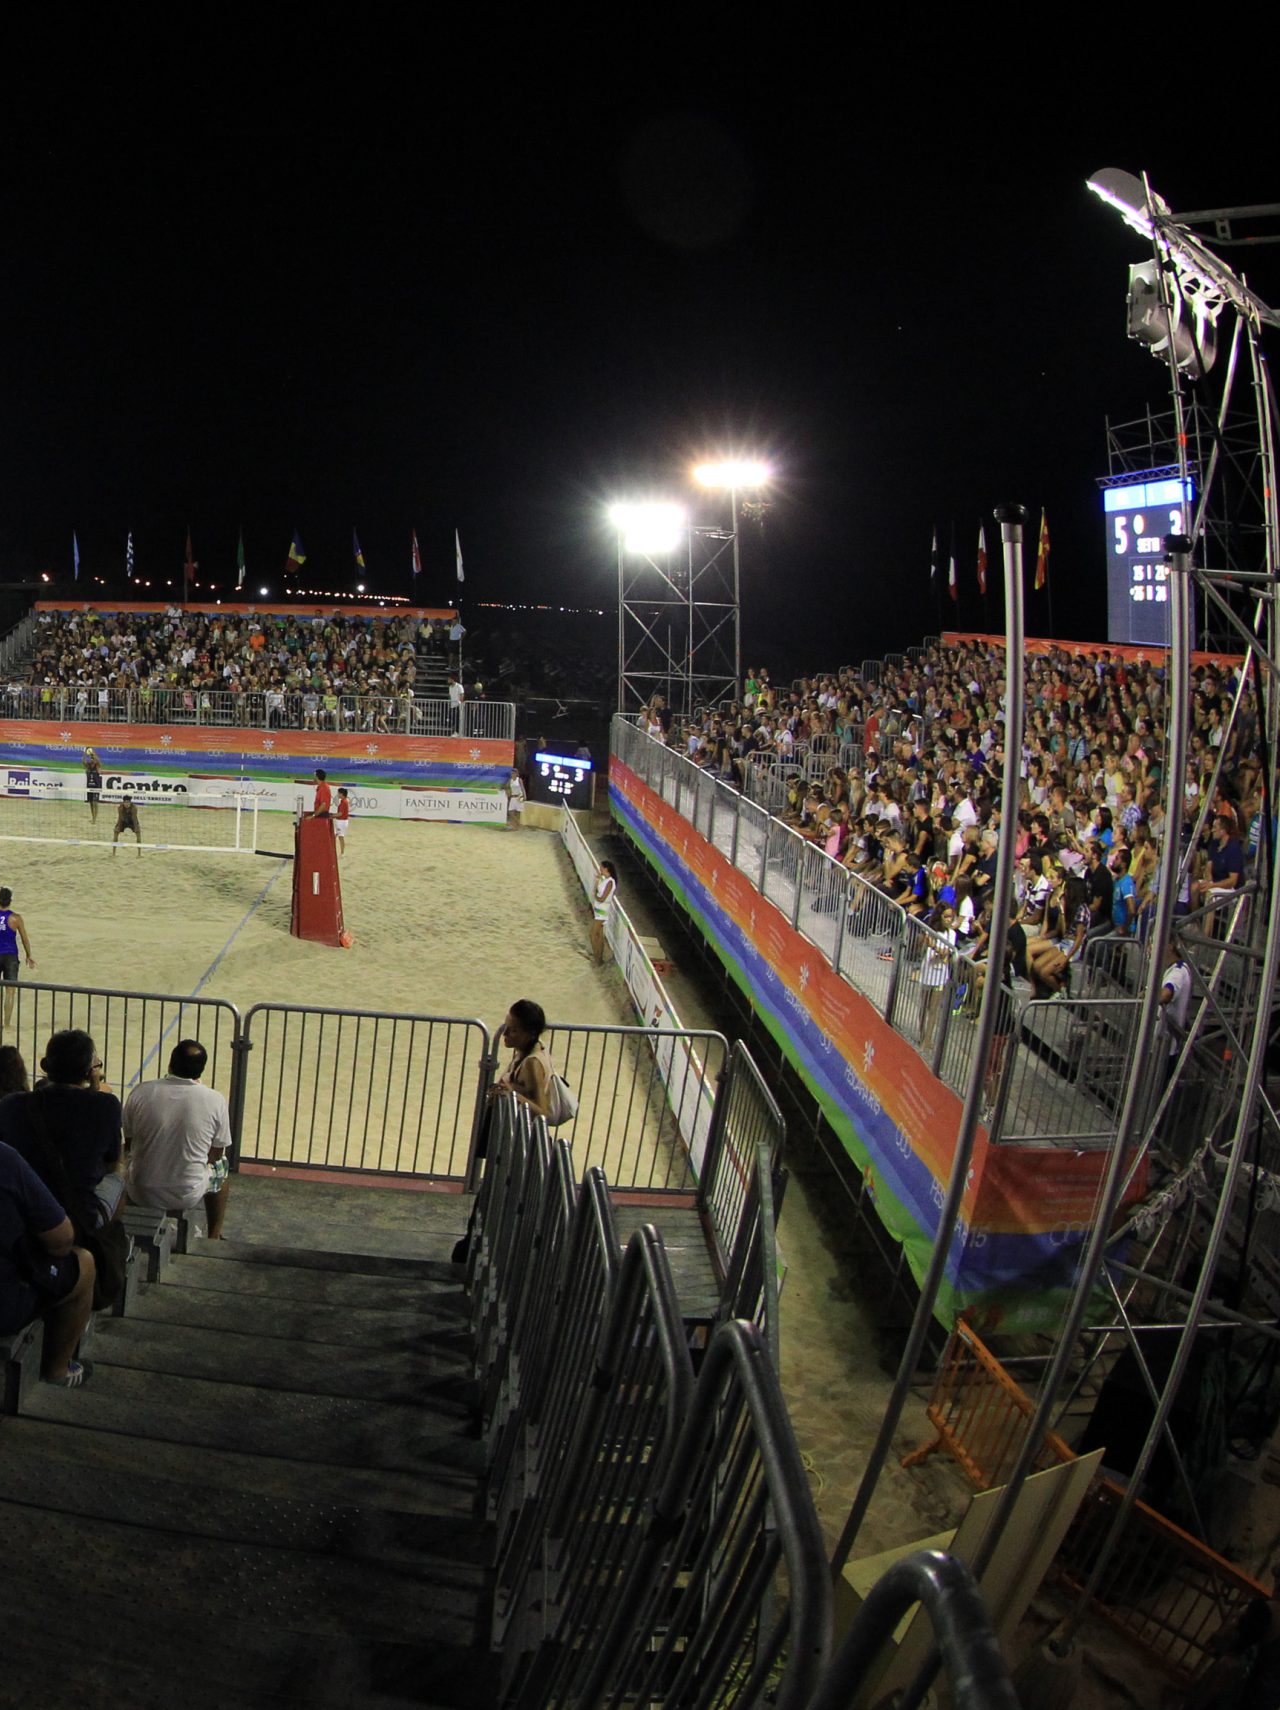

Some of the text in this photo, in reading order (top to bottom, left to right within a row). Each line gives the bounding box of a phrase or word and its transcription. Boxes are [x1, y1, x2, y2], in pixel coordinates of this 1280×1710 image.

[1115, 516, 1127, 554] 5
[106, 776, 187, 794] Centro
[406, 799, 502, 810] FANTINI FANTINI
[0, 916, 5, 924] 2
